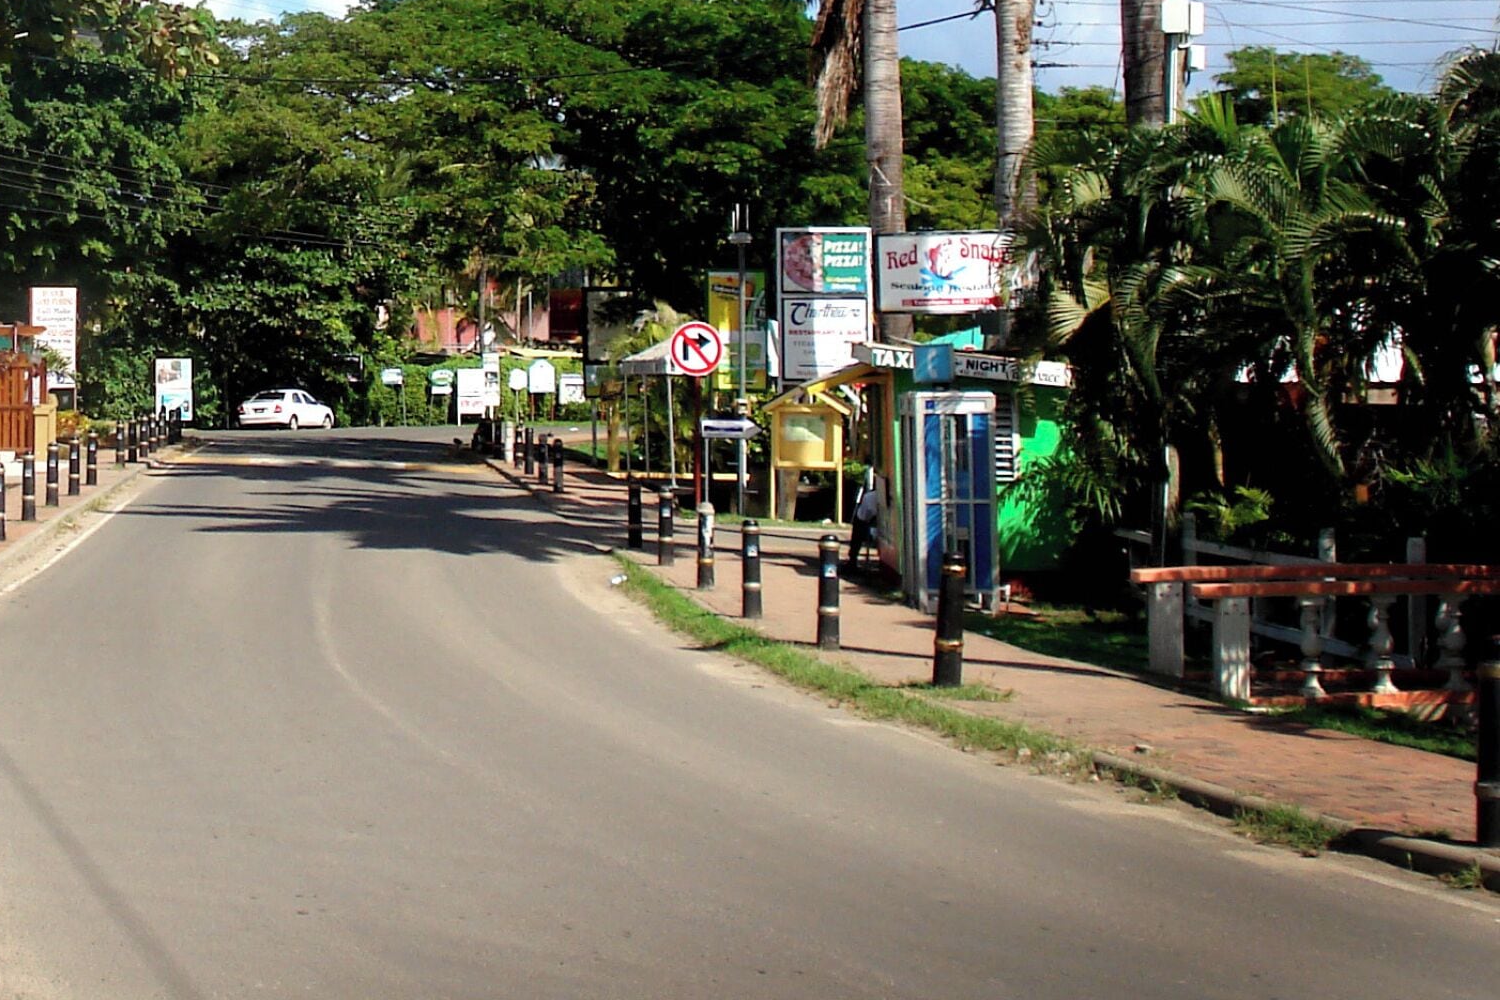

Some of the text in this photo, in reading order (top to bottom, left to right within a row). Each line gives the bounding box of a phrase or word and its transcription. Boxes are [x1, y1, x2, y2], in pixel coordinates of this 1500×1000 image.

[824, 240, 863, 253] PIZZA!
[824, 254, 863, 267] PIZZA!
[886, 244, 918, 269] Red
[872, 349, 914, 369] TAXI
[966, 359, 1008, 373] NIGHT
